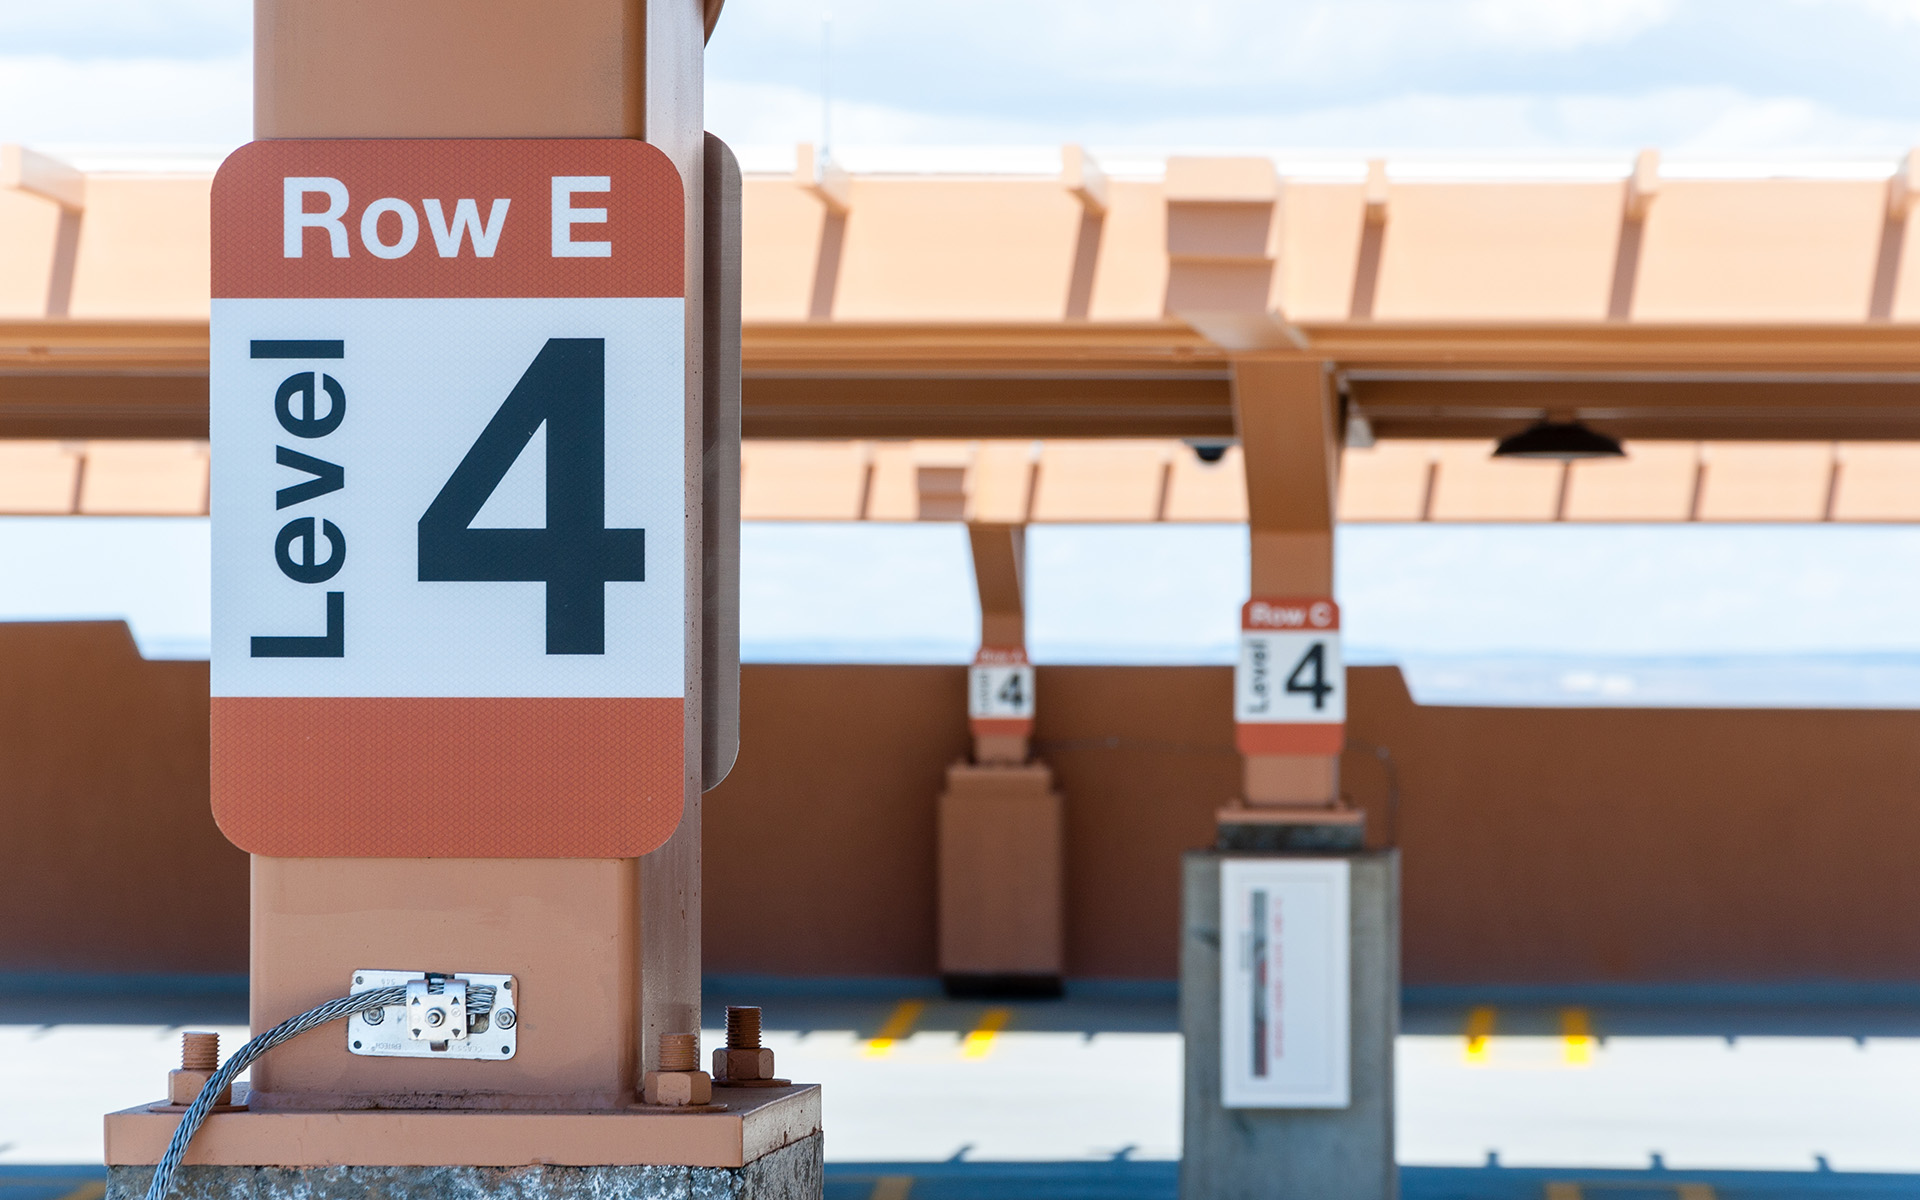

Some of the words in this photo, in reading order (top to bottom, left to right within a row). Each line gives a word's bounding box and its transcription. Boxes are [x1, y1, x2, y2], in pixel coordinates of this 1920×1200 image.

[283, 176, 511, 260] Row
[551, 176, 612, 258] E
[250, 339, 347, 658] Level
[418, 337, 646, 656] 4
[1250, 602, 1306, 627] Row
[998, 671, 1024, 709] 4
[1247, 639, 1269, 714] Level
[1285, 640, 1334, 711] 4
